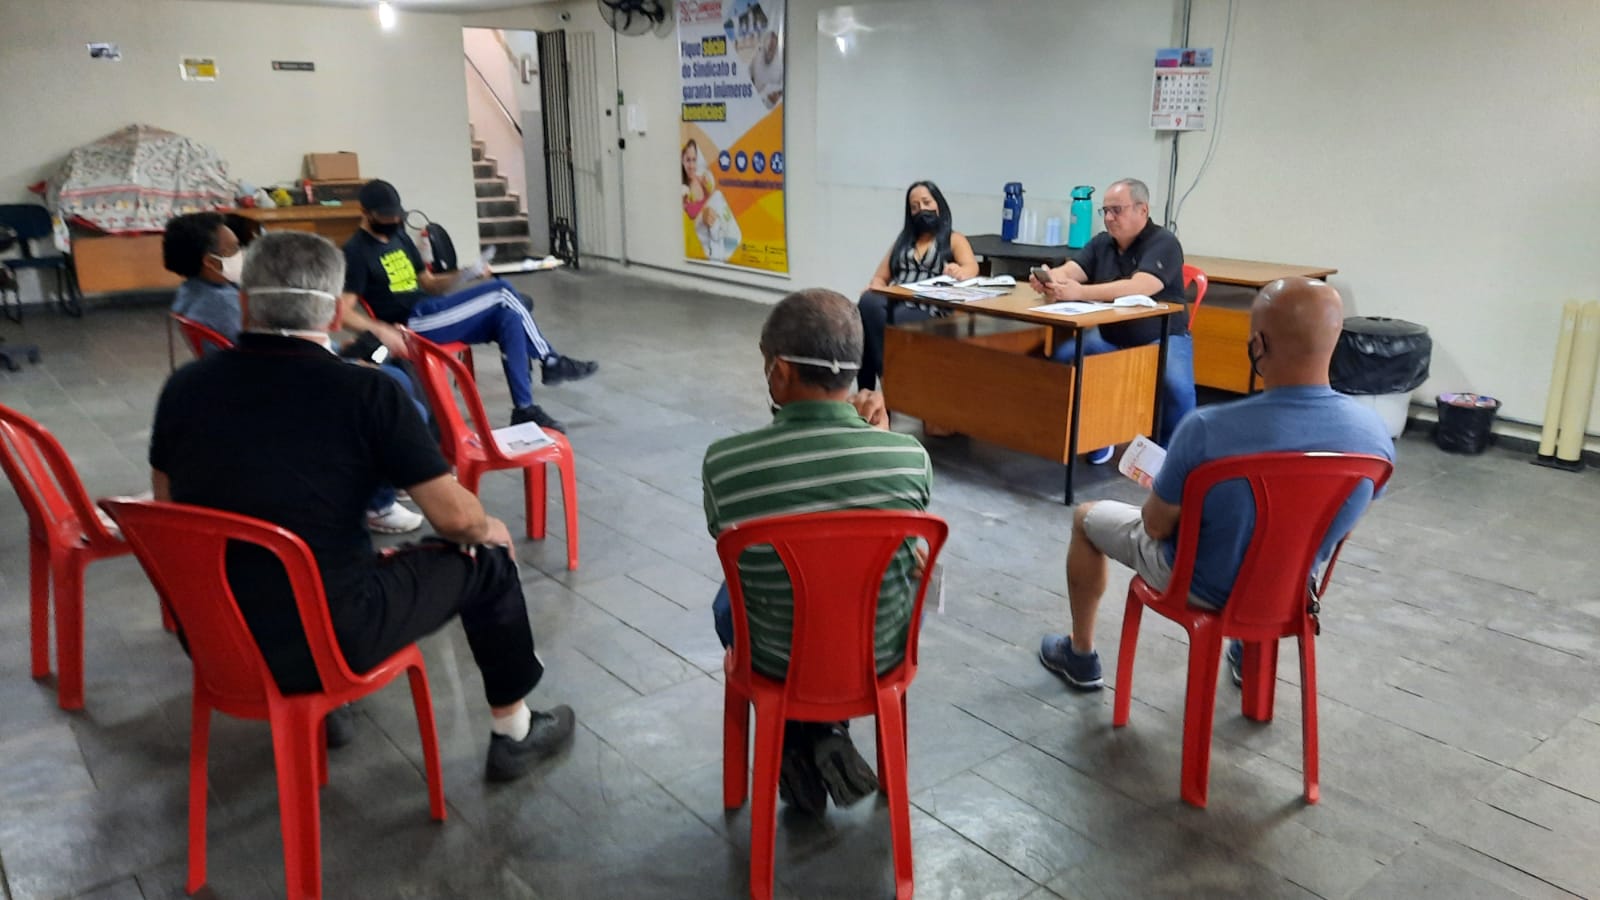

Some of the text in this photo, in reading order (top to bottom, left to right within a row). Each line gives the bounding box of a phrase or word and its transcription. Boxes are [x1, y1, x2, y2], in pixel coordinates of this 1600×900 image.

[681, 37, 726, 58] Fique sócio
[682, 61, 737, 78] do Sindicato e
[682, 81, 753, 102] garanta inúmeros
[1175, 117, 1182, 127] 9
